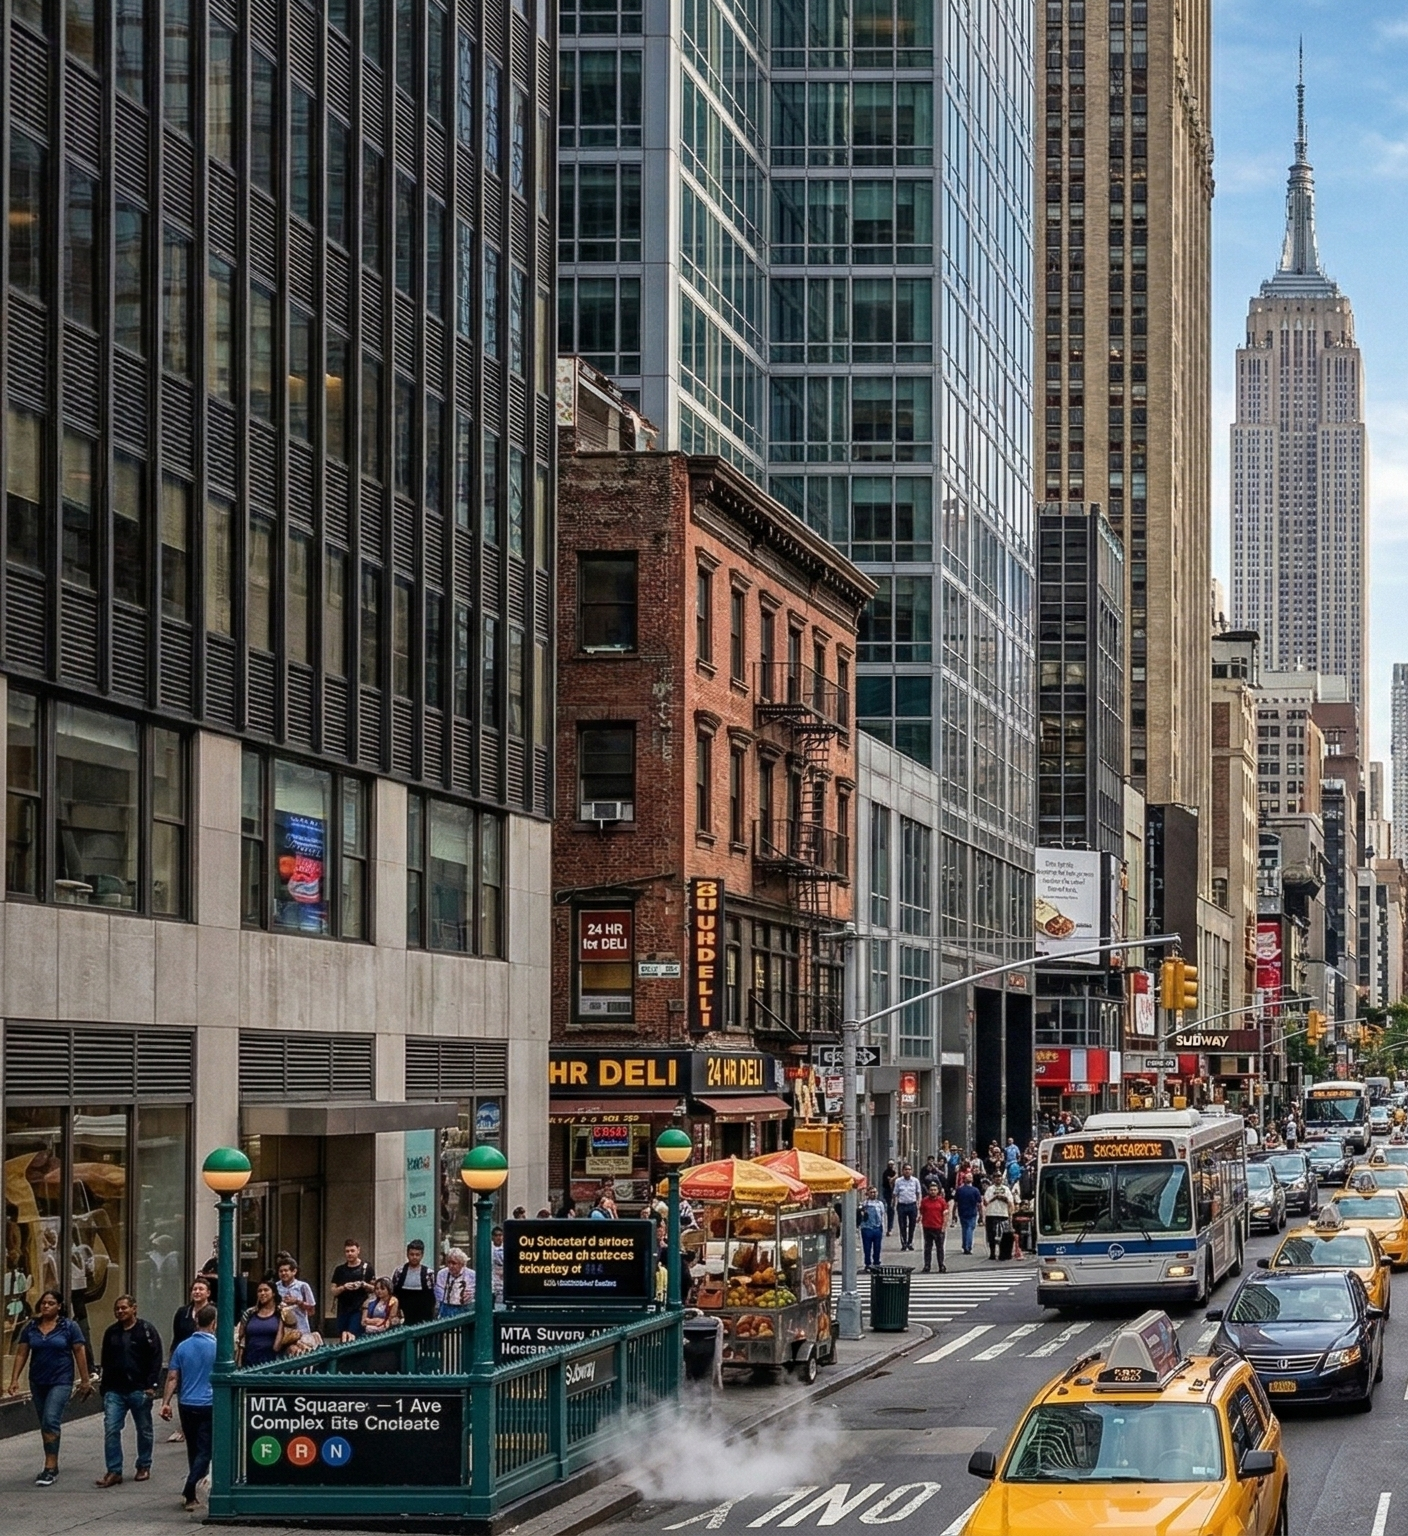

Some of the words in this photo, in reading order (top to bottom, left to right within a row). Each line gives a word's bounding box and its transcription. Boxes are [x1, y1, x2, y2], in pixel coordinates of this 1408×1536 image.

[587, 923, 603, 935] 24
[605, 923, 623, 935] HR
[601, 938, 627, 950] DELI
[549, 1061, 588, 1085] HR
[599, 1059, 677, 1086] DELI
[707, 1057, 721, 1086] 24
[723, 1058, 737, 1086] HR
[740, 1058, 763, 1086] DELI
[501, 1327, 532, 1340] MTA
[250, 1396, 288, 1413] MTA
[410, 1398, 442, 1413] Ave
[250, 1414, 324, 1433] Complex
[330, 1444, 343, 1458] N
